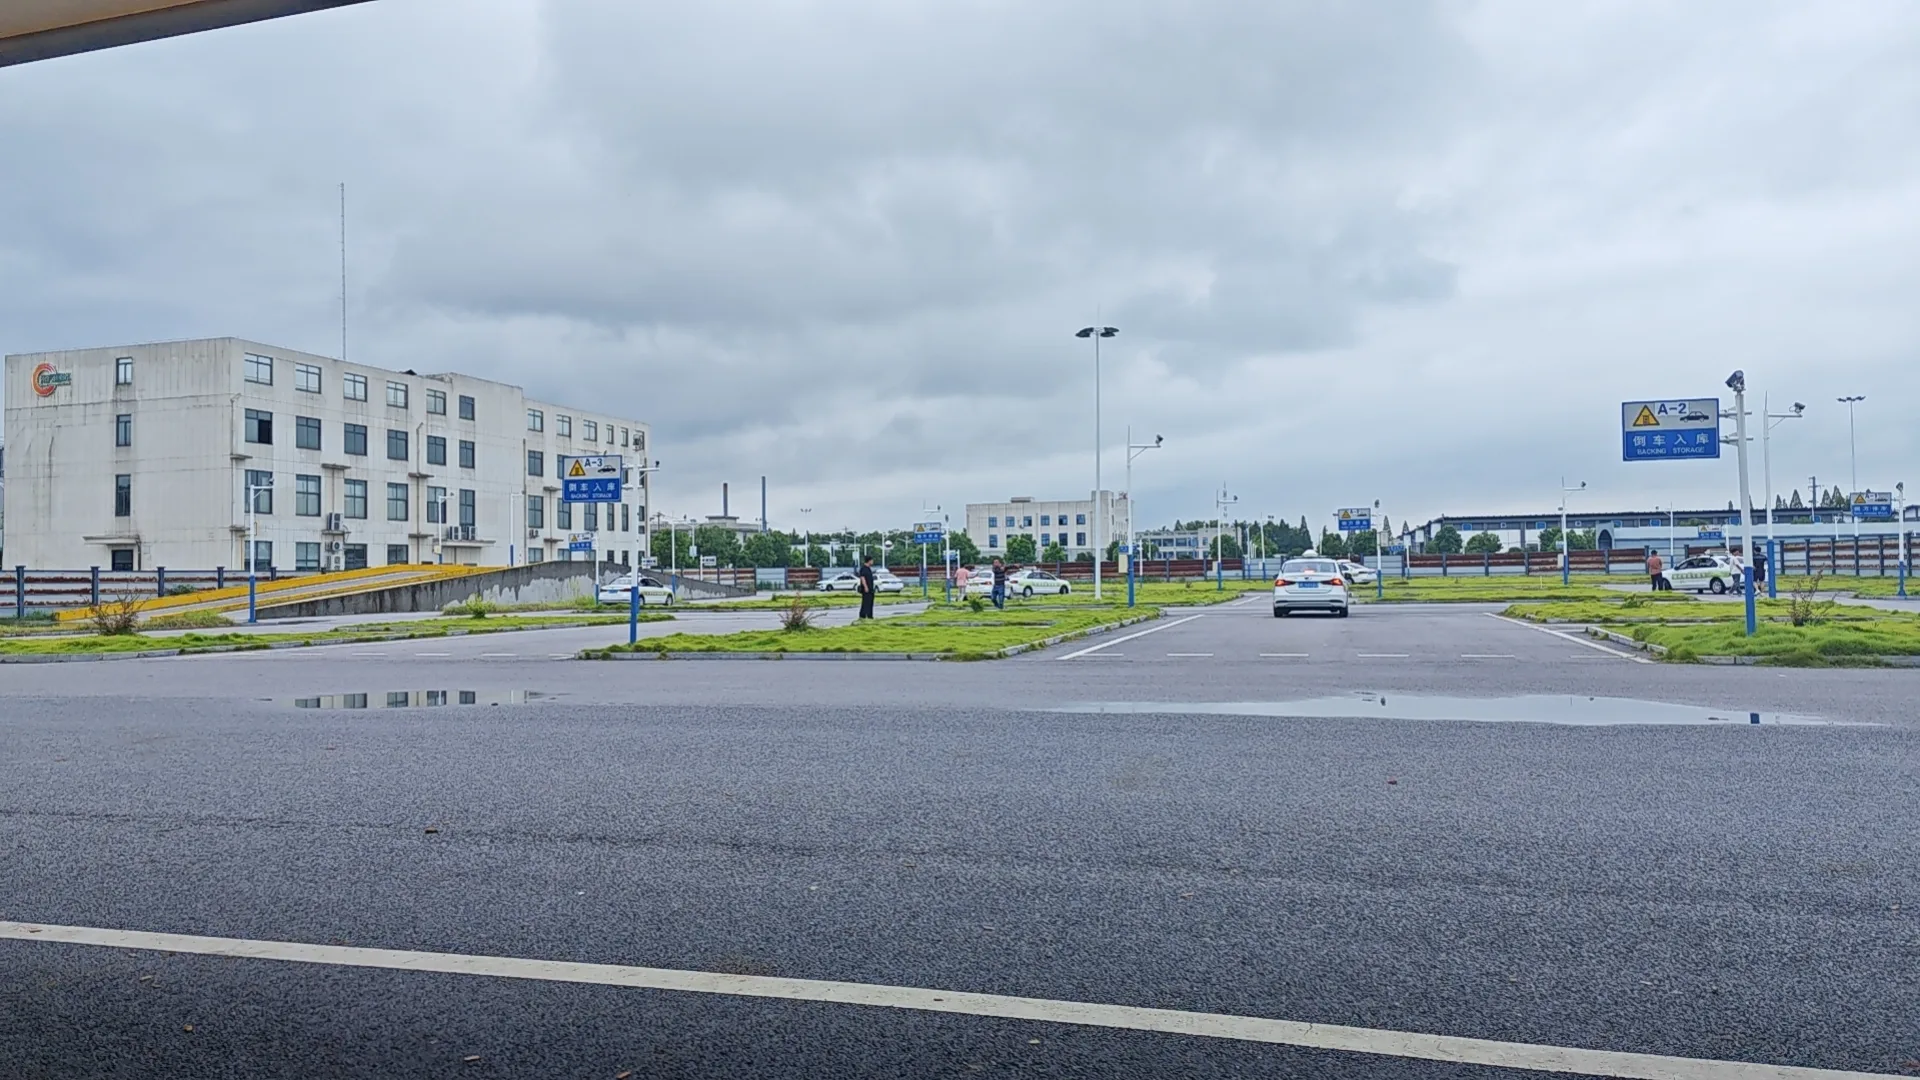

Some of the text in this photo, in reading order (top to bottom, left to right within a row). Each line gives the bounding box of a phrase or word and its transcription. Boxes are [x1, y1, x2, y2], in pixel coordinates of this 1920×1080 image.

[1657, 403, 1687, 415] A-2
[1632, 432, 1709, 447] 倒车入库
[1637, 446, 1705, 455] BACKING STORAGE
[584, 458, 603, 467] A-3
